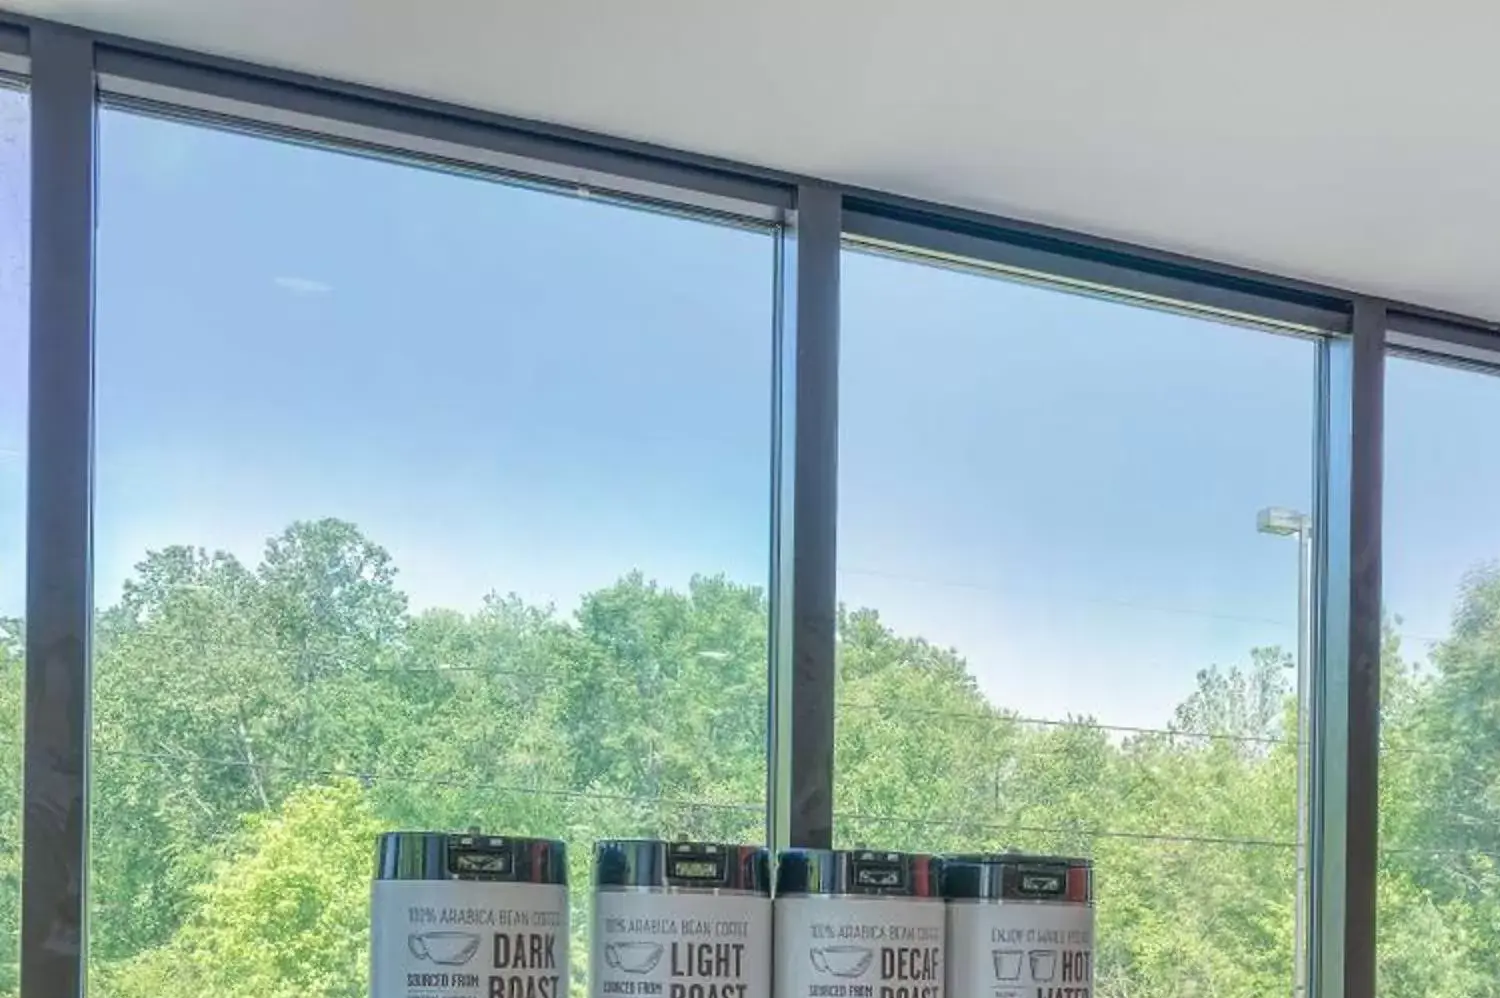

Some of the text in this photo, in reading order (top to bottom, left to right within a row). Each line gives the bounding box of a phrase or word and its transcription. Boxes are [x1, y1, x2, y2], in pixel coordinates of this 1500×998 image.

[439, 907, 495, 925] ARABICA
[493, 932, 556, 969] DARK
[671, 942, 745, 977] LIGHT
[880, 946, 941, 981] DECAF
[1062, 950, 1091, 982] HOT
[451, 973, 479, 987] FROM
